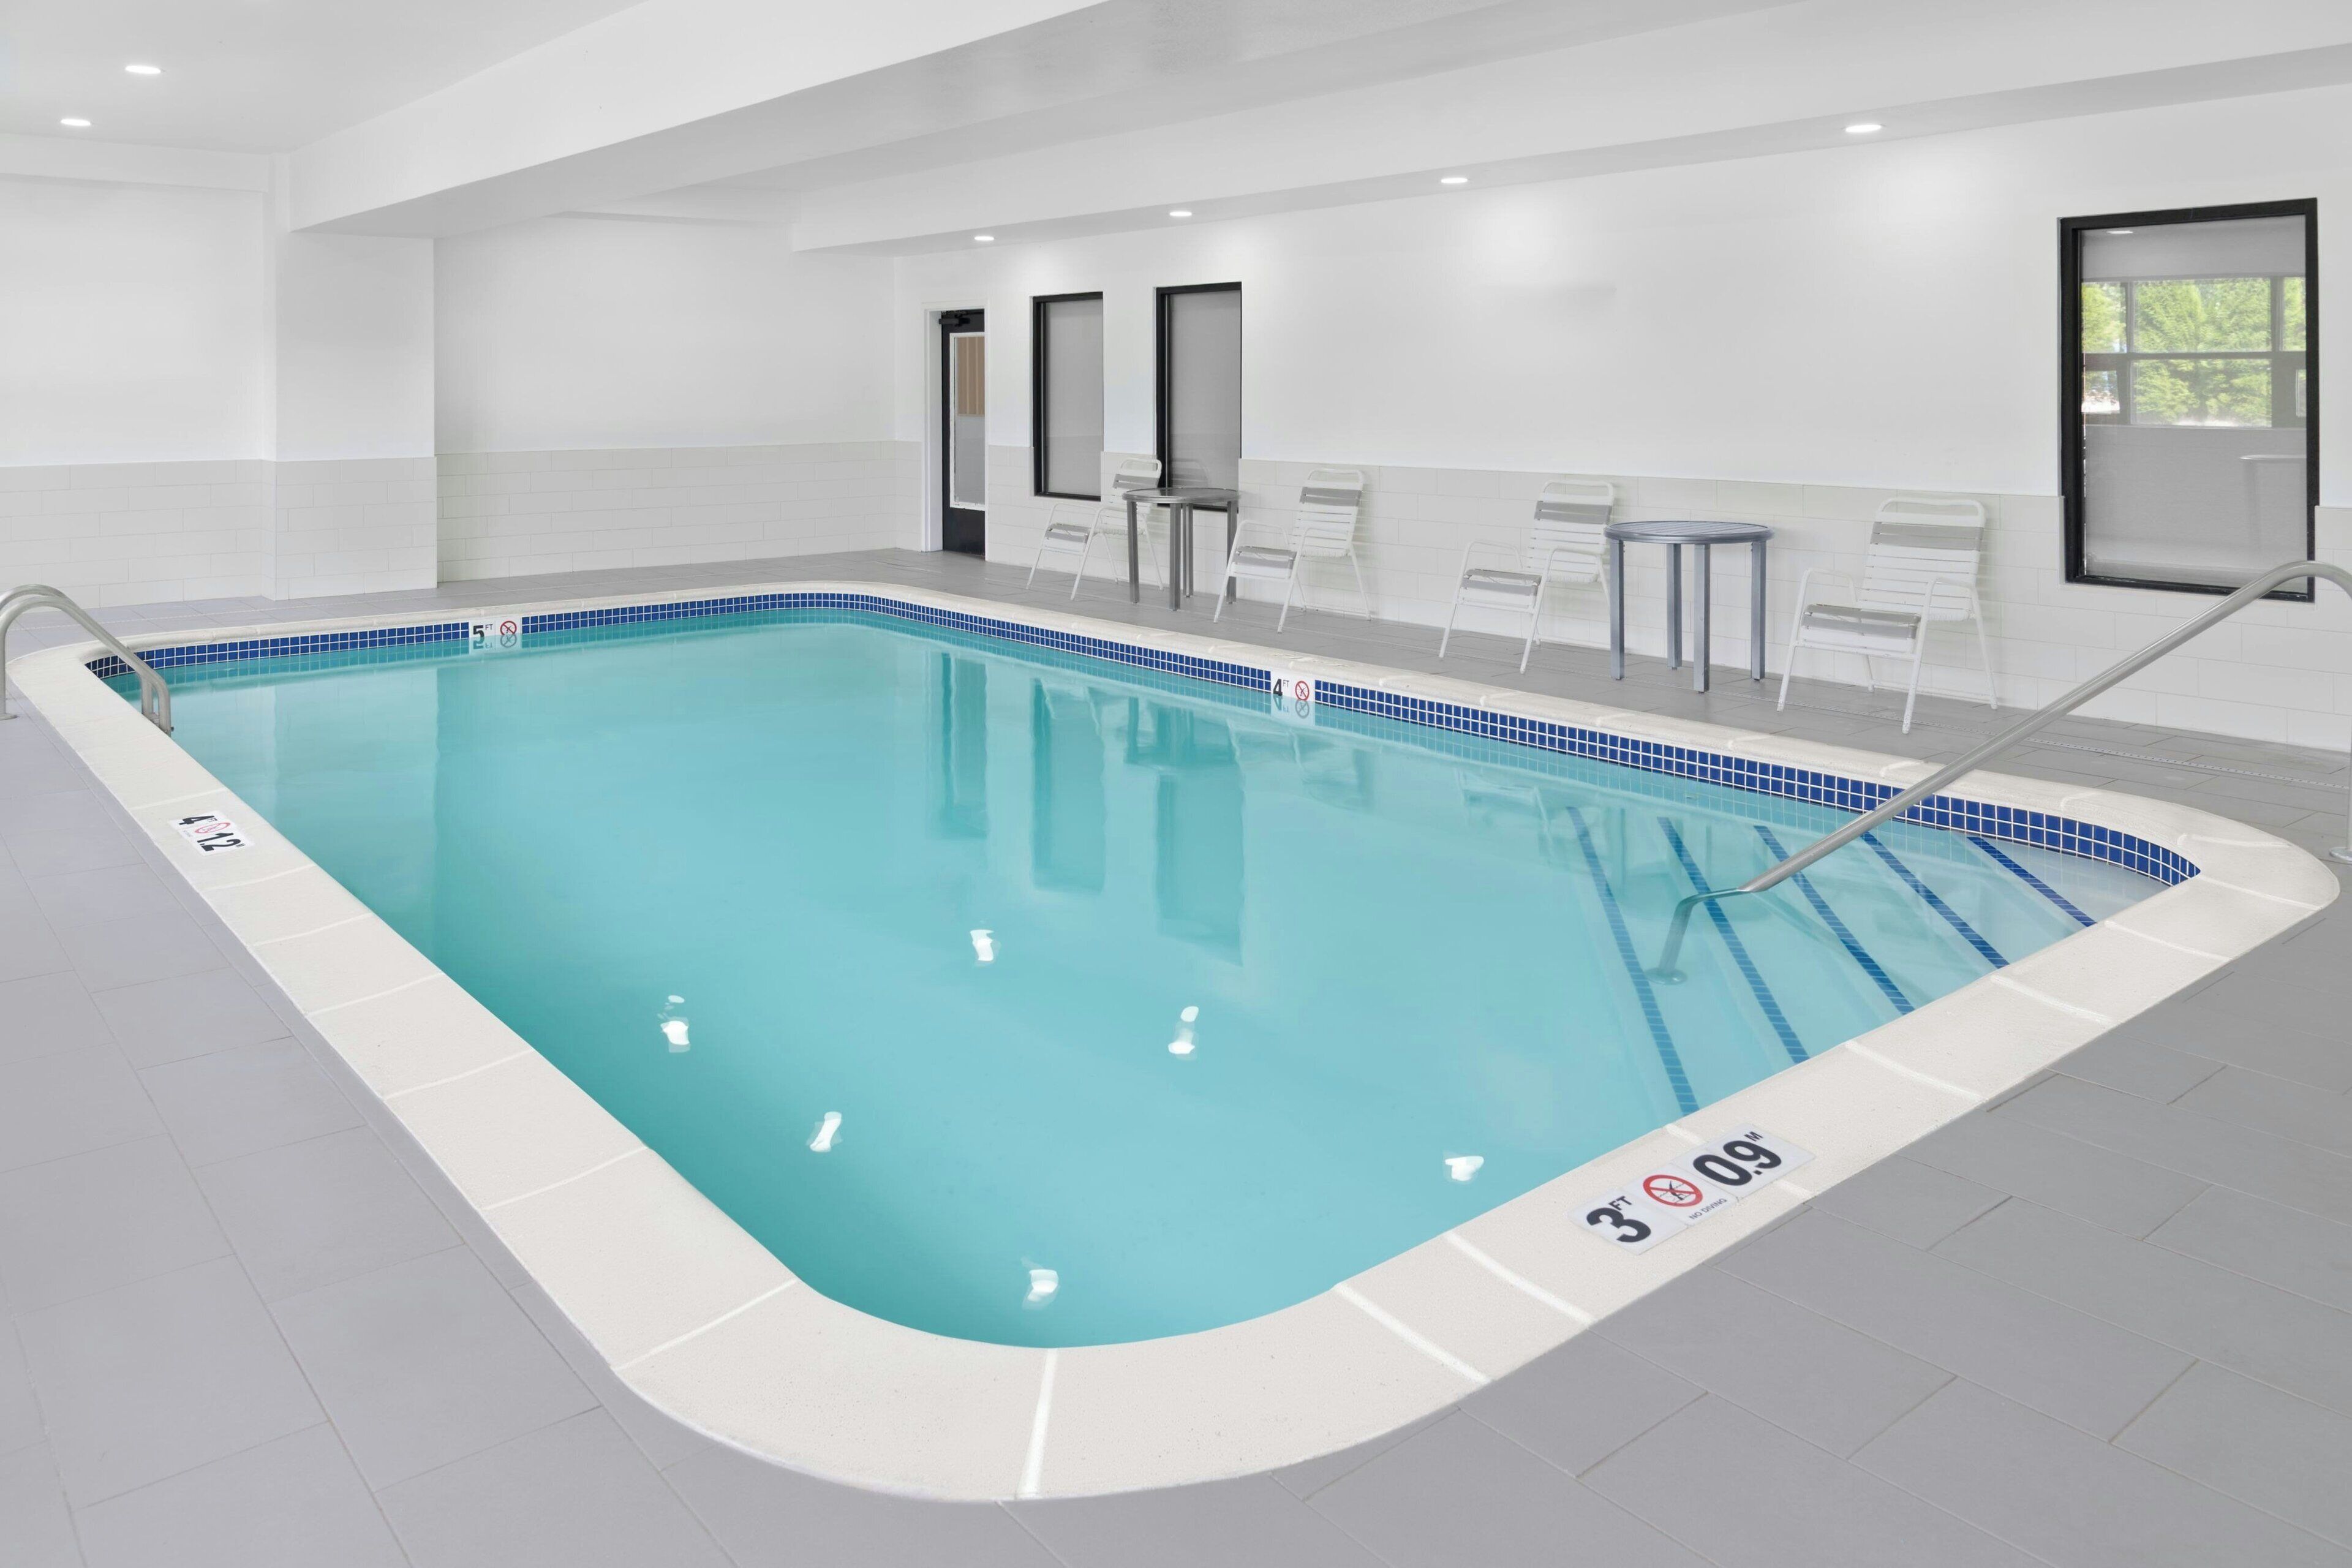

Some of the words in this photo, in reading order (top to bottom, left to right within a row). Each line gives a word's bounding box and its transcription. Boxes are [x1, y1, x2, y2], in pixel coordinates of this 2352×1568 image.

[473, 625, 484, 638] 5
[1273, 679, 1283, 696] 4
[179, 815, 215, 825] 4
[197, 832, 241, 851] 1.2
[1692, 1140, 1782, 1186] 0.9
[1744, 1131, 1764, 1142] M
[1609, 1196, 1633, 1212] FT
[1701, 1197, 1727, 1213] DIVING
[1586, 1207, 1651, 1243] 3
